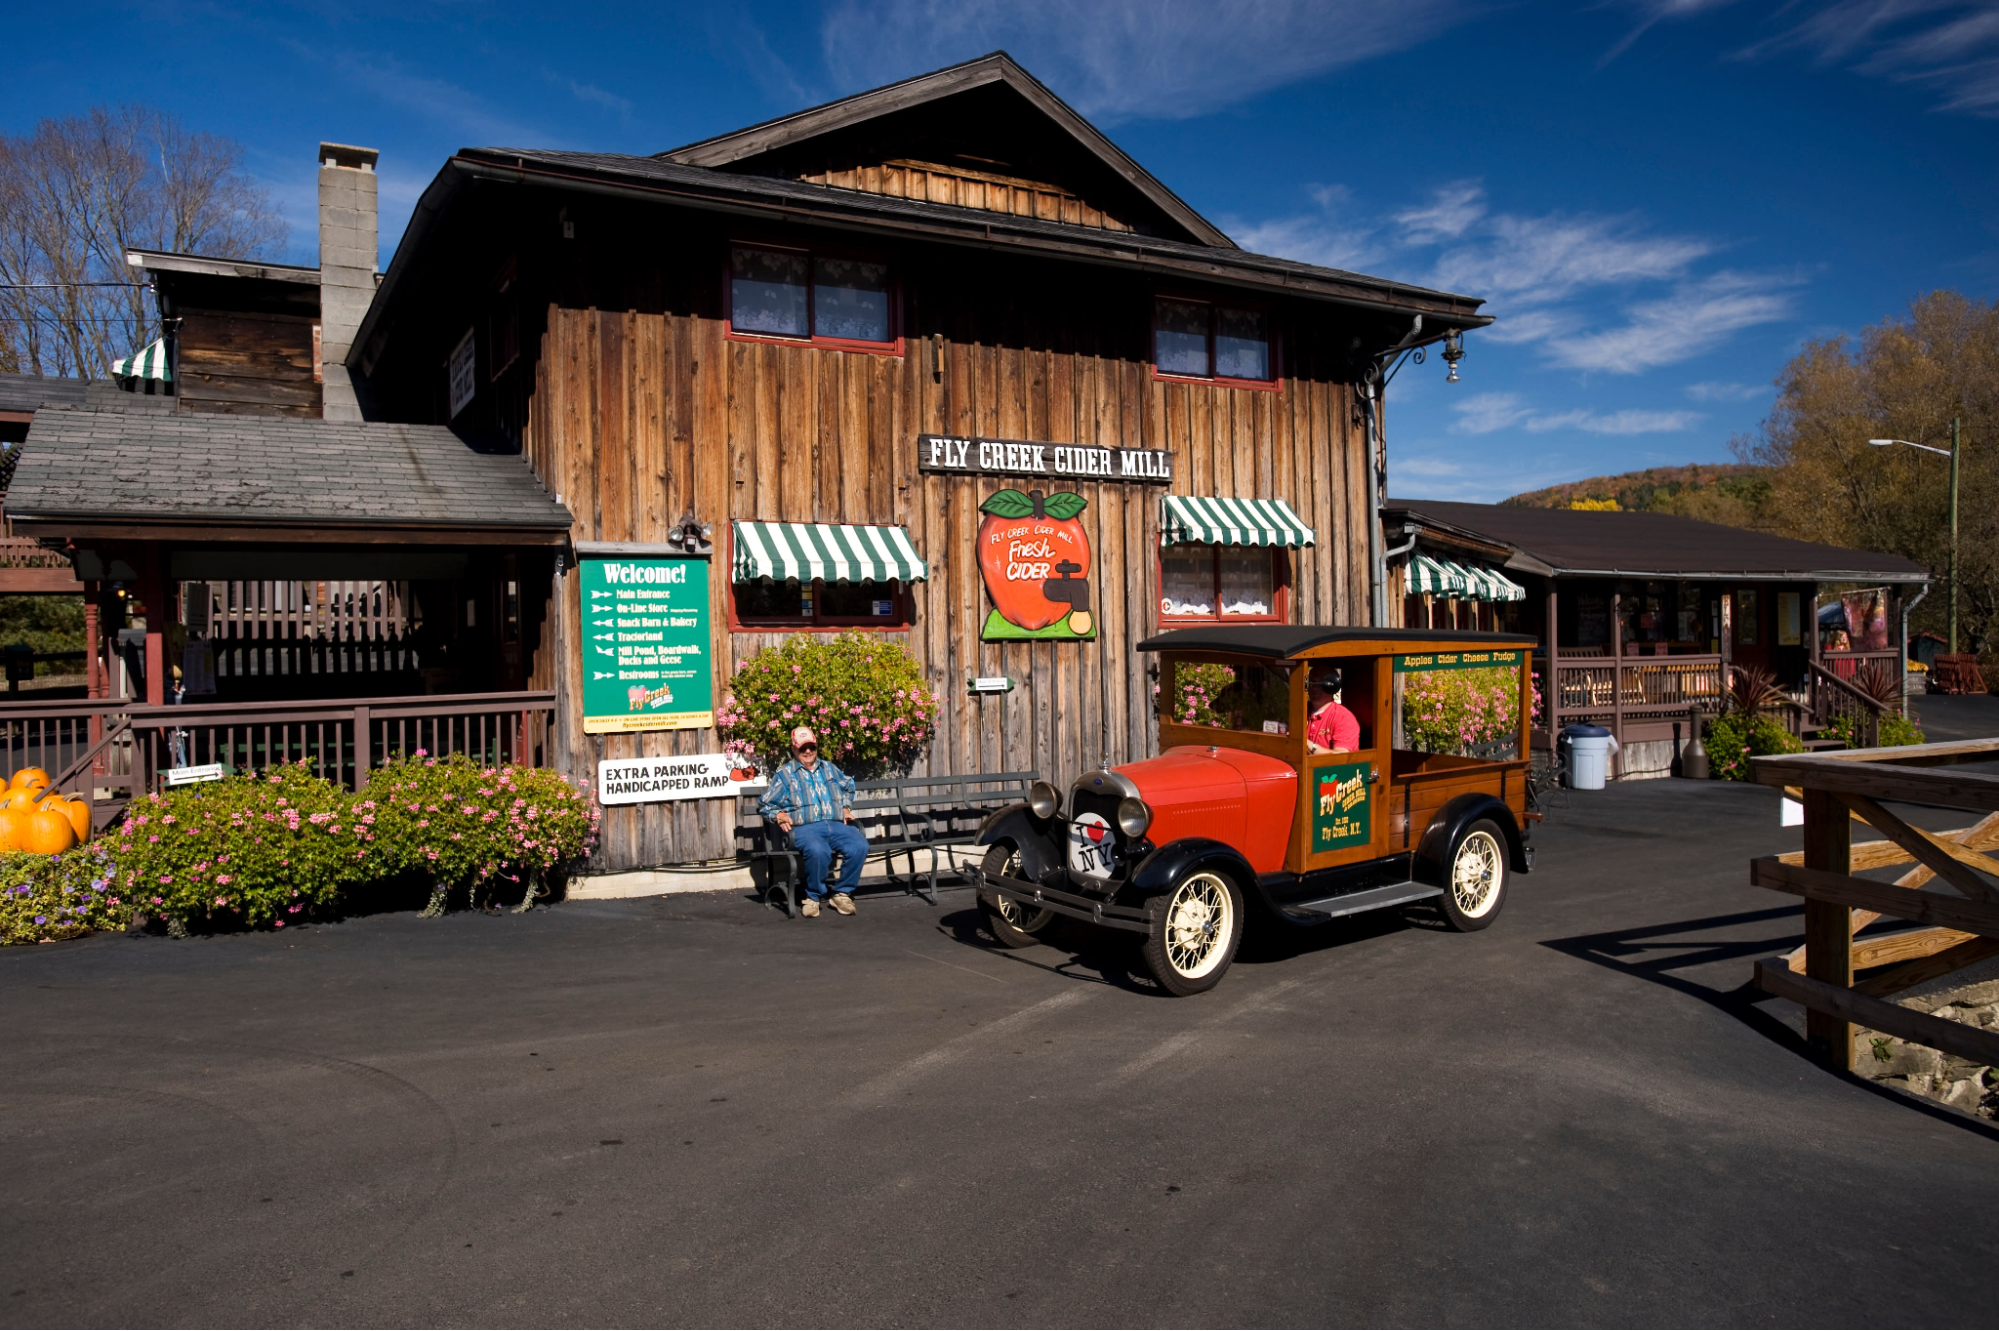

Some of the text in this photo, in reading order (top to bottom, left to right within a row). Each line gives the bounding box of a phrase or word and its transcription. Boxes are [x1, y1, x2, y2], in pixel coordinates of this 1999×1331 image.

[929, 438, 1170, 478] FLY CREEK CIDER MILL
[991, 524, 1073, 545] FLY CREEK CIDER MILL
[1008, 537, 1056, 562] Fresh
[603, 563, 686, 584] Welcome!
[1006, 561, 1051, 581] CIDER
[616, 589, 671, 599] Main Entrance
[616, 603, 647, 613] On-Line
[648, 603, 668, 613] Store
[617, 617, 697, 628] Snack Barn & Bakery
[617, 631, 663, 641] Tractorland
[618, 644, 701, 656] Mill Pond, Boardwalk,
[1404, 652, 1516, 667] Apples Cider Cheese Fudge
[618, 655, 682, 666] Ducks and Geese
[618, 670, 659, 680] Restrooms
[629, 697, 644, 711] Fly
[644, 682, 670, 703] Creek
[605, 763, 709, 780] EXTRA PARKING
[606, 775, 729, 795] HANDICAPPED RAMP
[1320, 794, 1336, 816] Fly
[1336, 768, 1363, 803] Creek
[1075, 825, 1088, 848] I
[1322, 827, 1332, 841] Fly
[1350, 821, 1362, 835] N.Y.
[1078, 842, 1111, 873] NY
